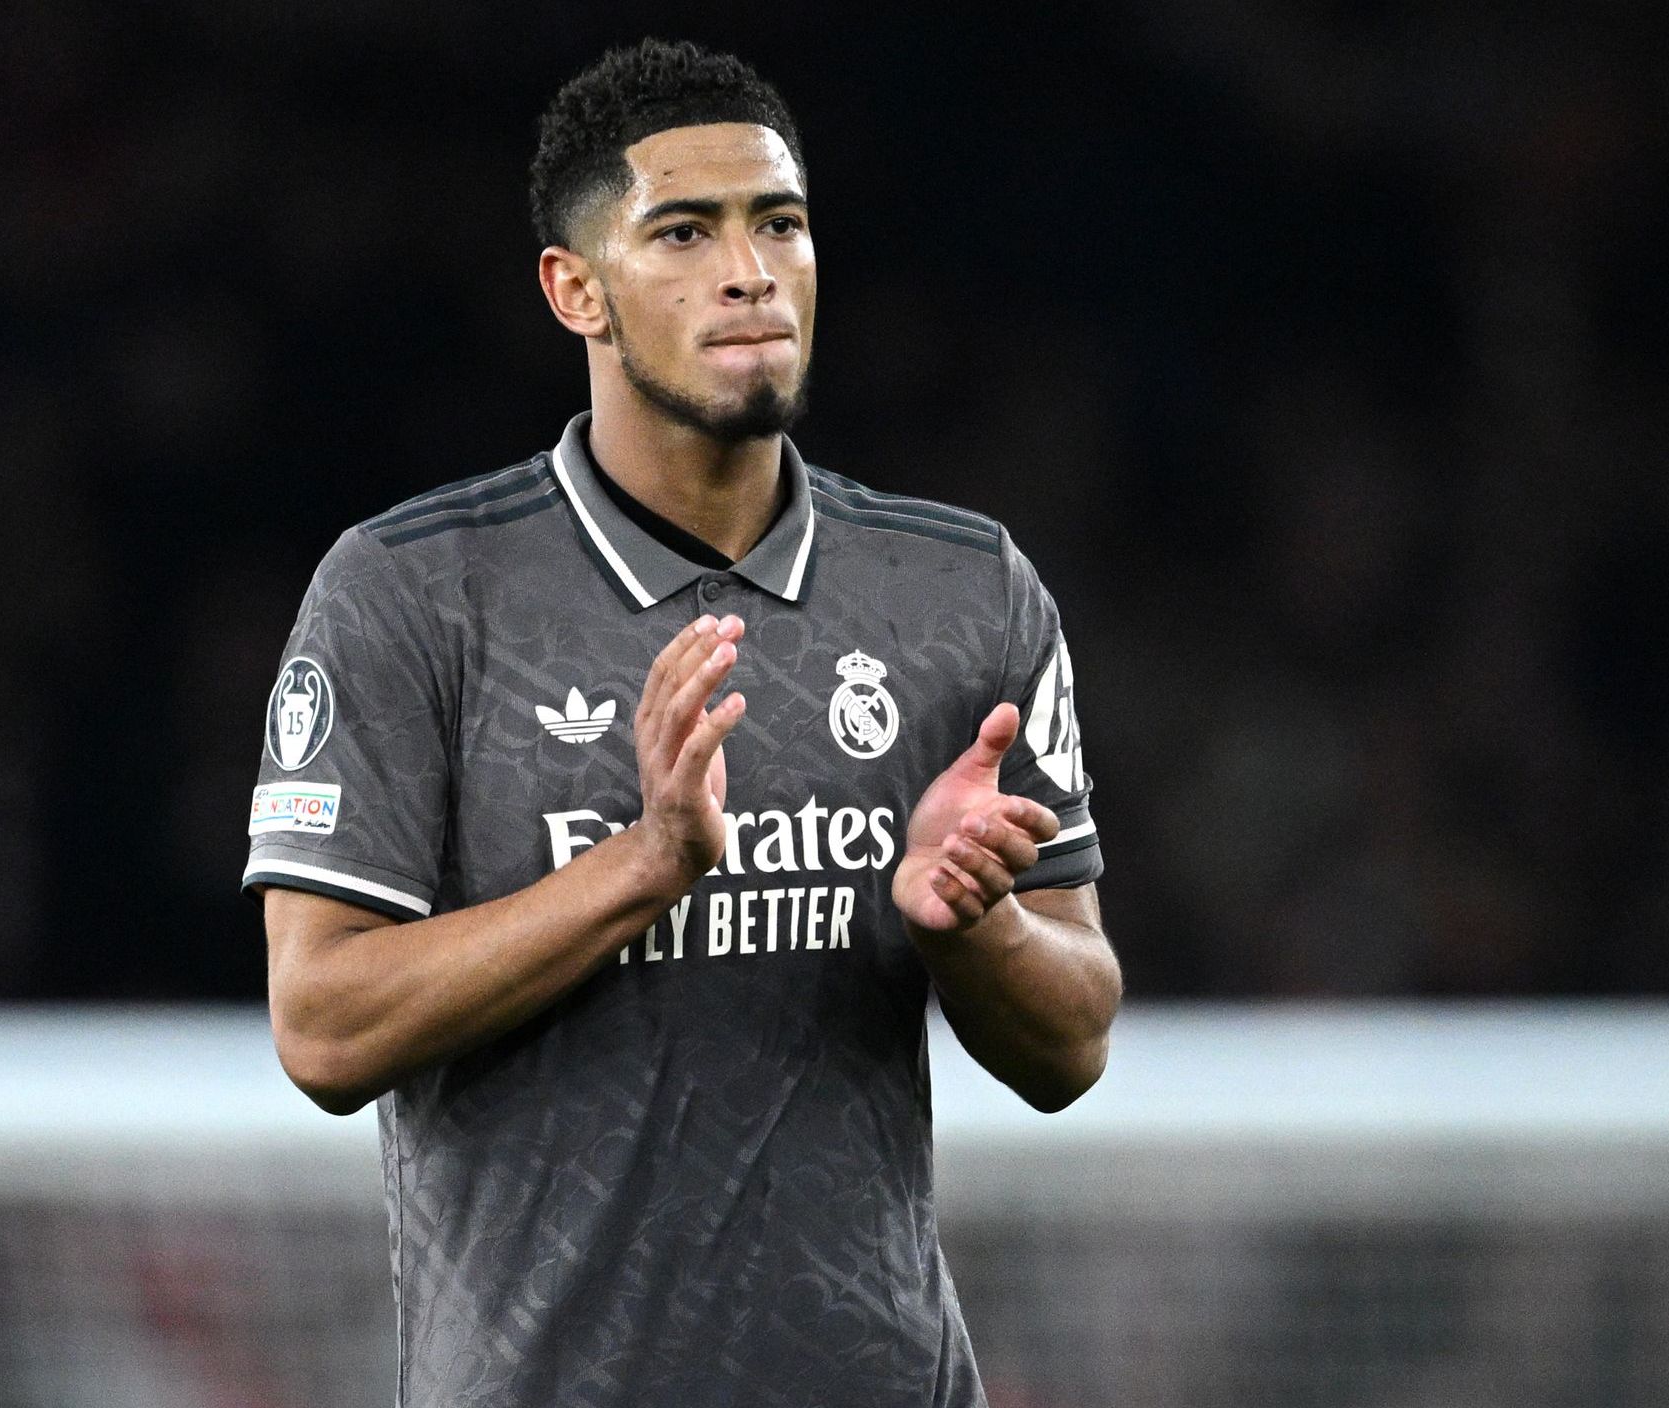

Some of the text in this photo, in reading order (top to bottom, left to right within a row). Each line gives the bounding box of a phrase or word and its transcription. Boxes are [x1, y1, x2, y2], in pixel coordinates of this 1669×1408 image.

[286, 711, 304, 735] 15
[542, 794, 895, 877] Erates
[708, 886, 856, 957] BETTER
